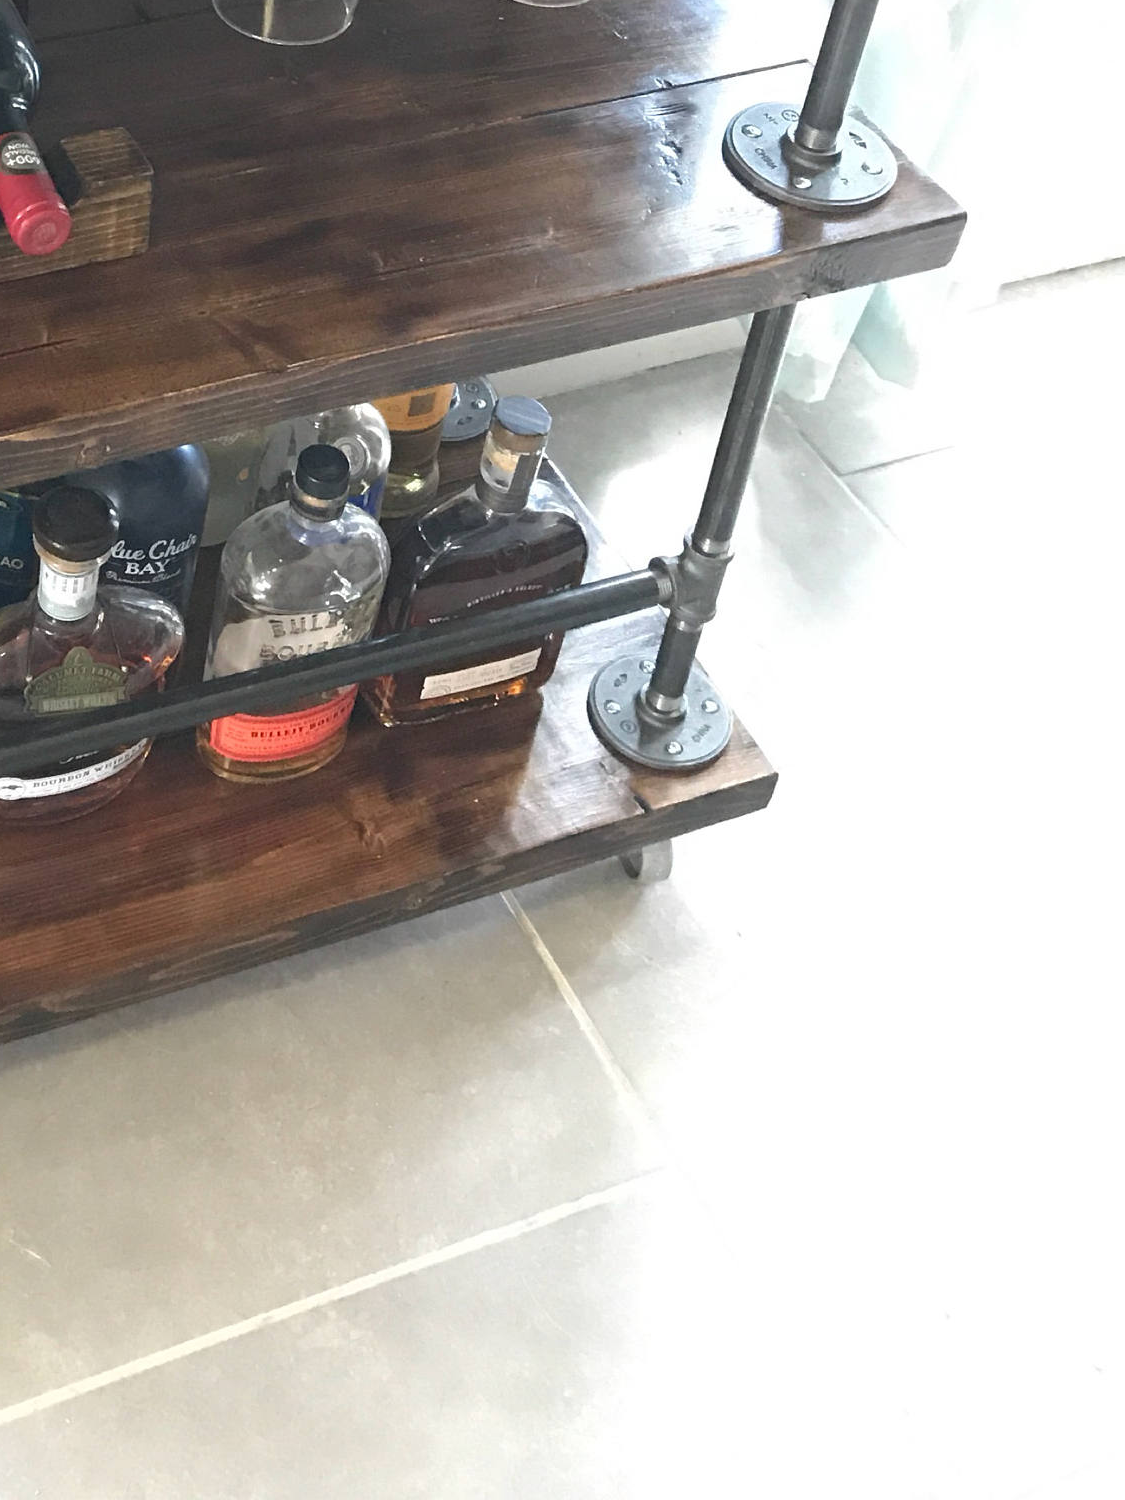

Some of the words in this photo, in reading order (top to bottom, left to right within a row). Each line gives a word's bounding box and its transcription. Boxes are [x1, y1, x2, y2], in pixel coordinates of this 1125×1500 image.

[110, 539, 146, 561] lue
[149, 533, 198, 560] Chair
[125, 558, 170, 575] BAY
[33, 770, 91, 788] BOURBON
